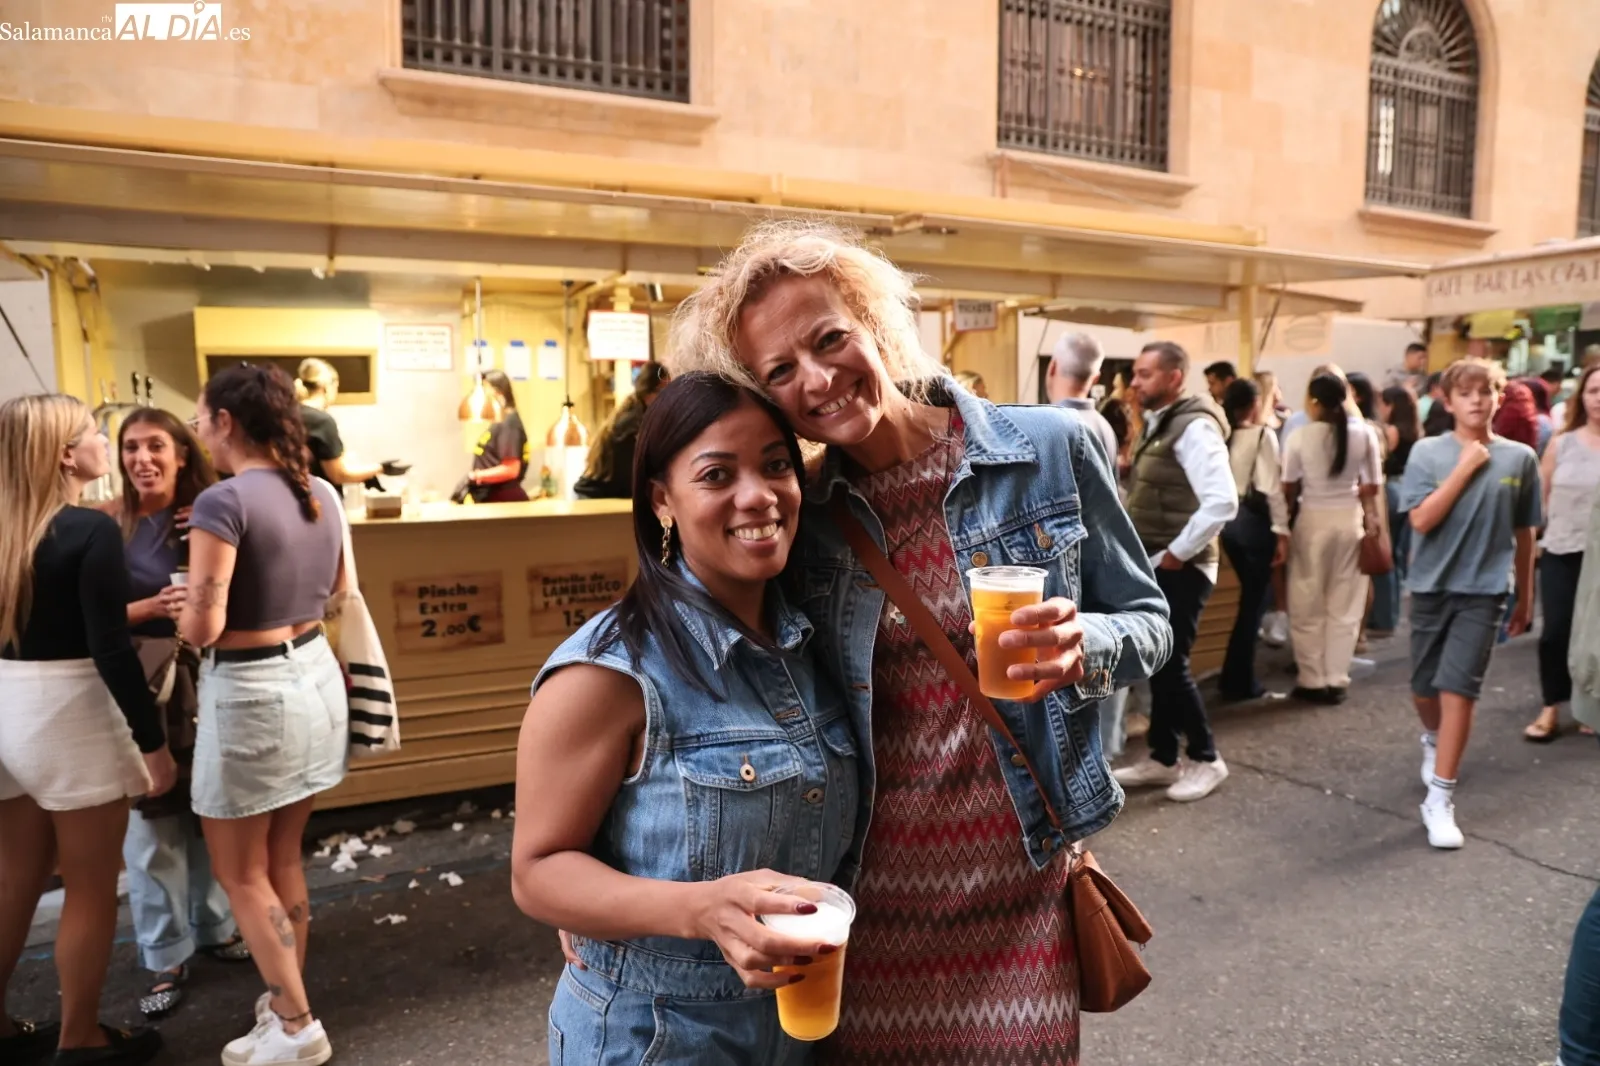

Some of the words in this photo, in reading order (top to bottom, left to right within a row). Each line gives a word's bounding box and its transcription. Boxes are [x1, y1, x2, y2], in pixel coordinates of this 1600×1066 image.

[417, 582, 479, 599] Pincho
[542, 580, 621, 598] LAMBRUSCO
[419, 601, 468, 615] Extra
